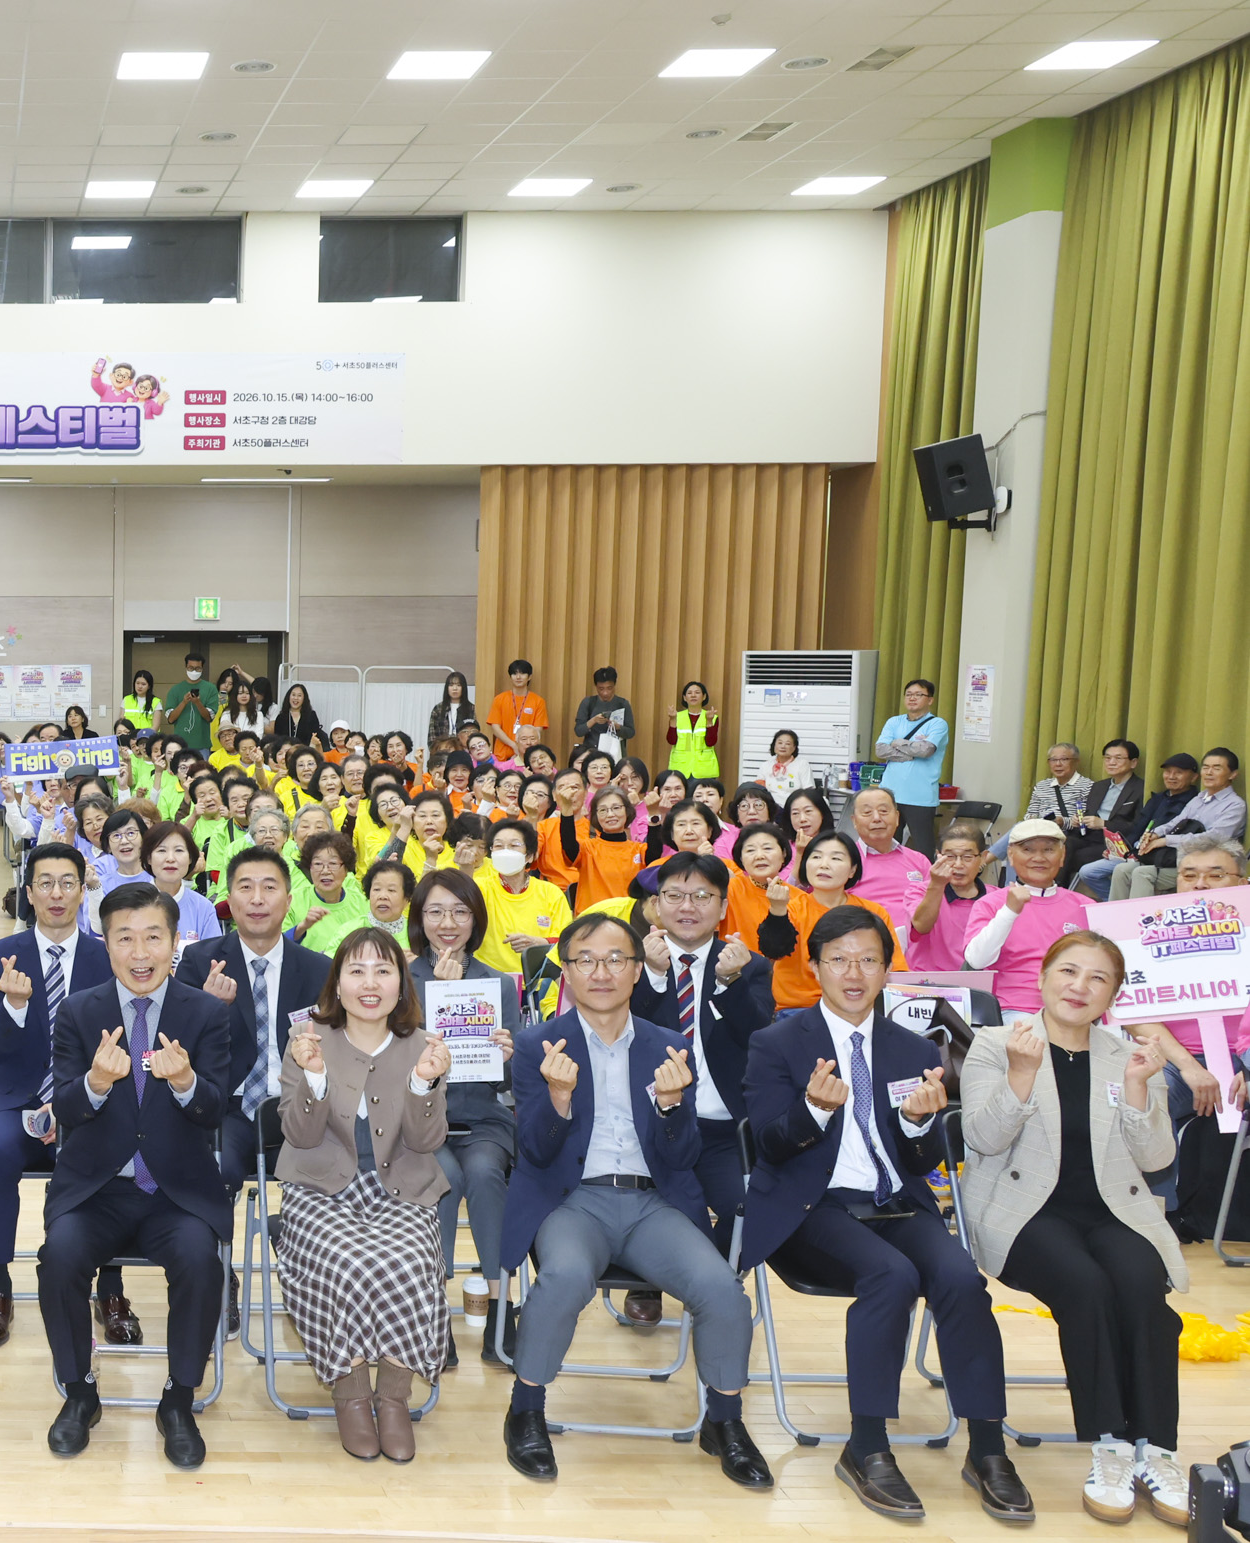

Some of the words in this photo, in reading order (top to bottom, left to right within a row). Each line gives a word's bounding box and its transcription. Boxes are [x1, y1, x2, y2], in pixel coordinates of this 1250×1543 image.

[342, 361, 398, 370] 서초50플러스센터
[188, 393, 222, 403] 행사일시
[311, 392, 374, 403] 14:00~16:00
[188, 416, 221, 426] 행사장소
[232, 416, 269, 426] 서초구청
[271, 416, 287, 426] 2층
[289, 415, 317, 426] 대강당
[187, 438, 221, 449] 주최기관
[232, 438, 309, 448] 서초50플러스센터
[1163, 906, 1208, 926] 서초
[1141, 919, 1241, 945] 스마트시니어
[1151, 936, 1236, 958] IT페스티벌
[1115, 979, 1239, 1007] 스마트시니어
[450, 1003, 476, 1016] 서초
[907, 1006, 934, 1020] 내빈
[435, 1016, 494, 1028] 스마트시니어
